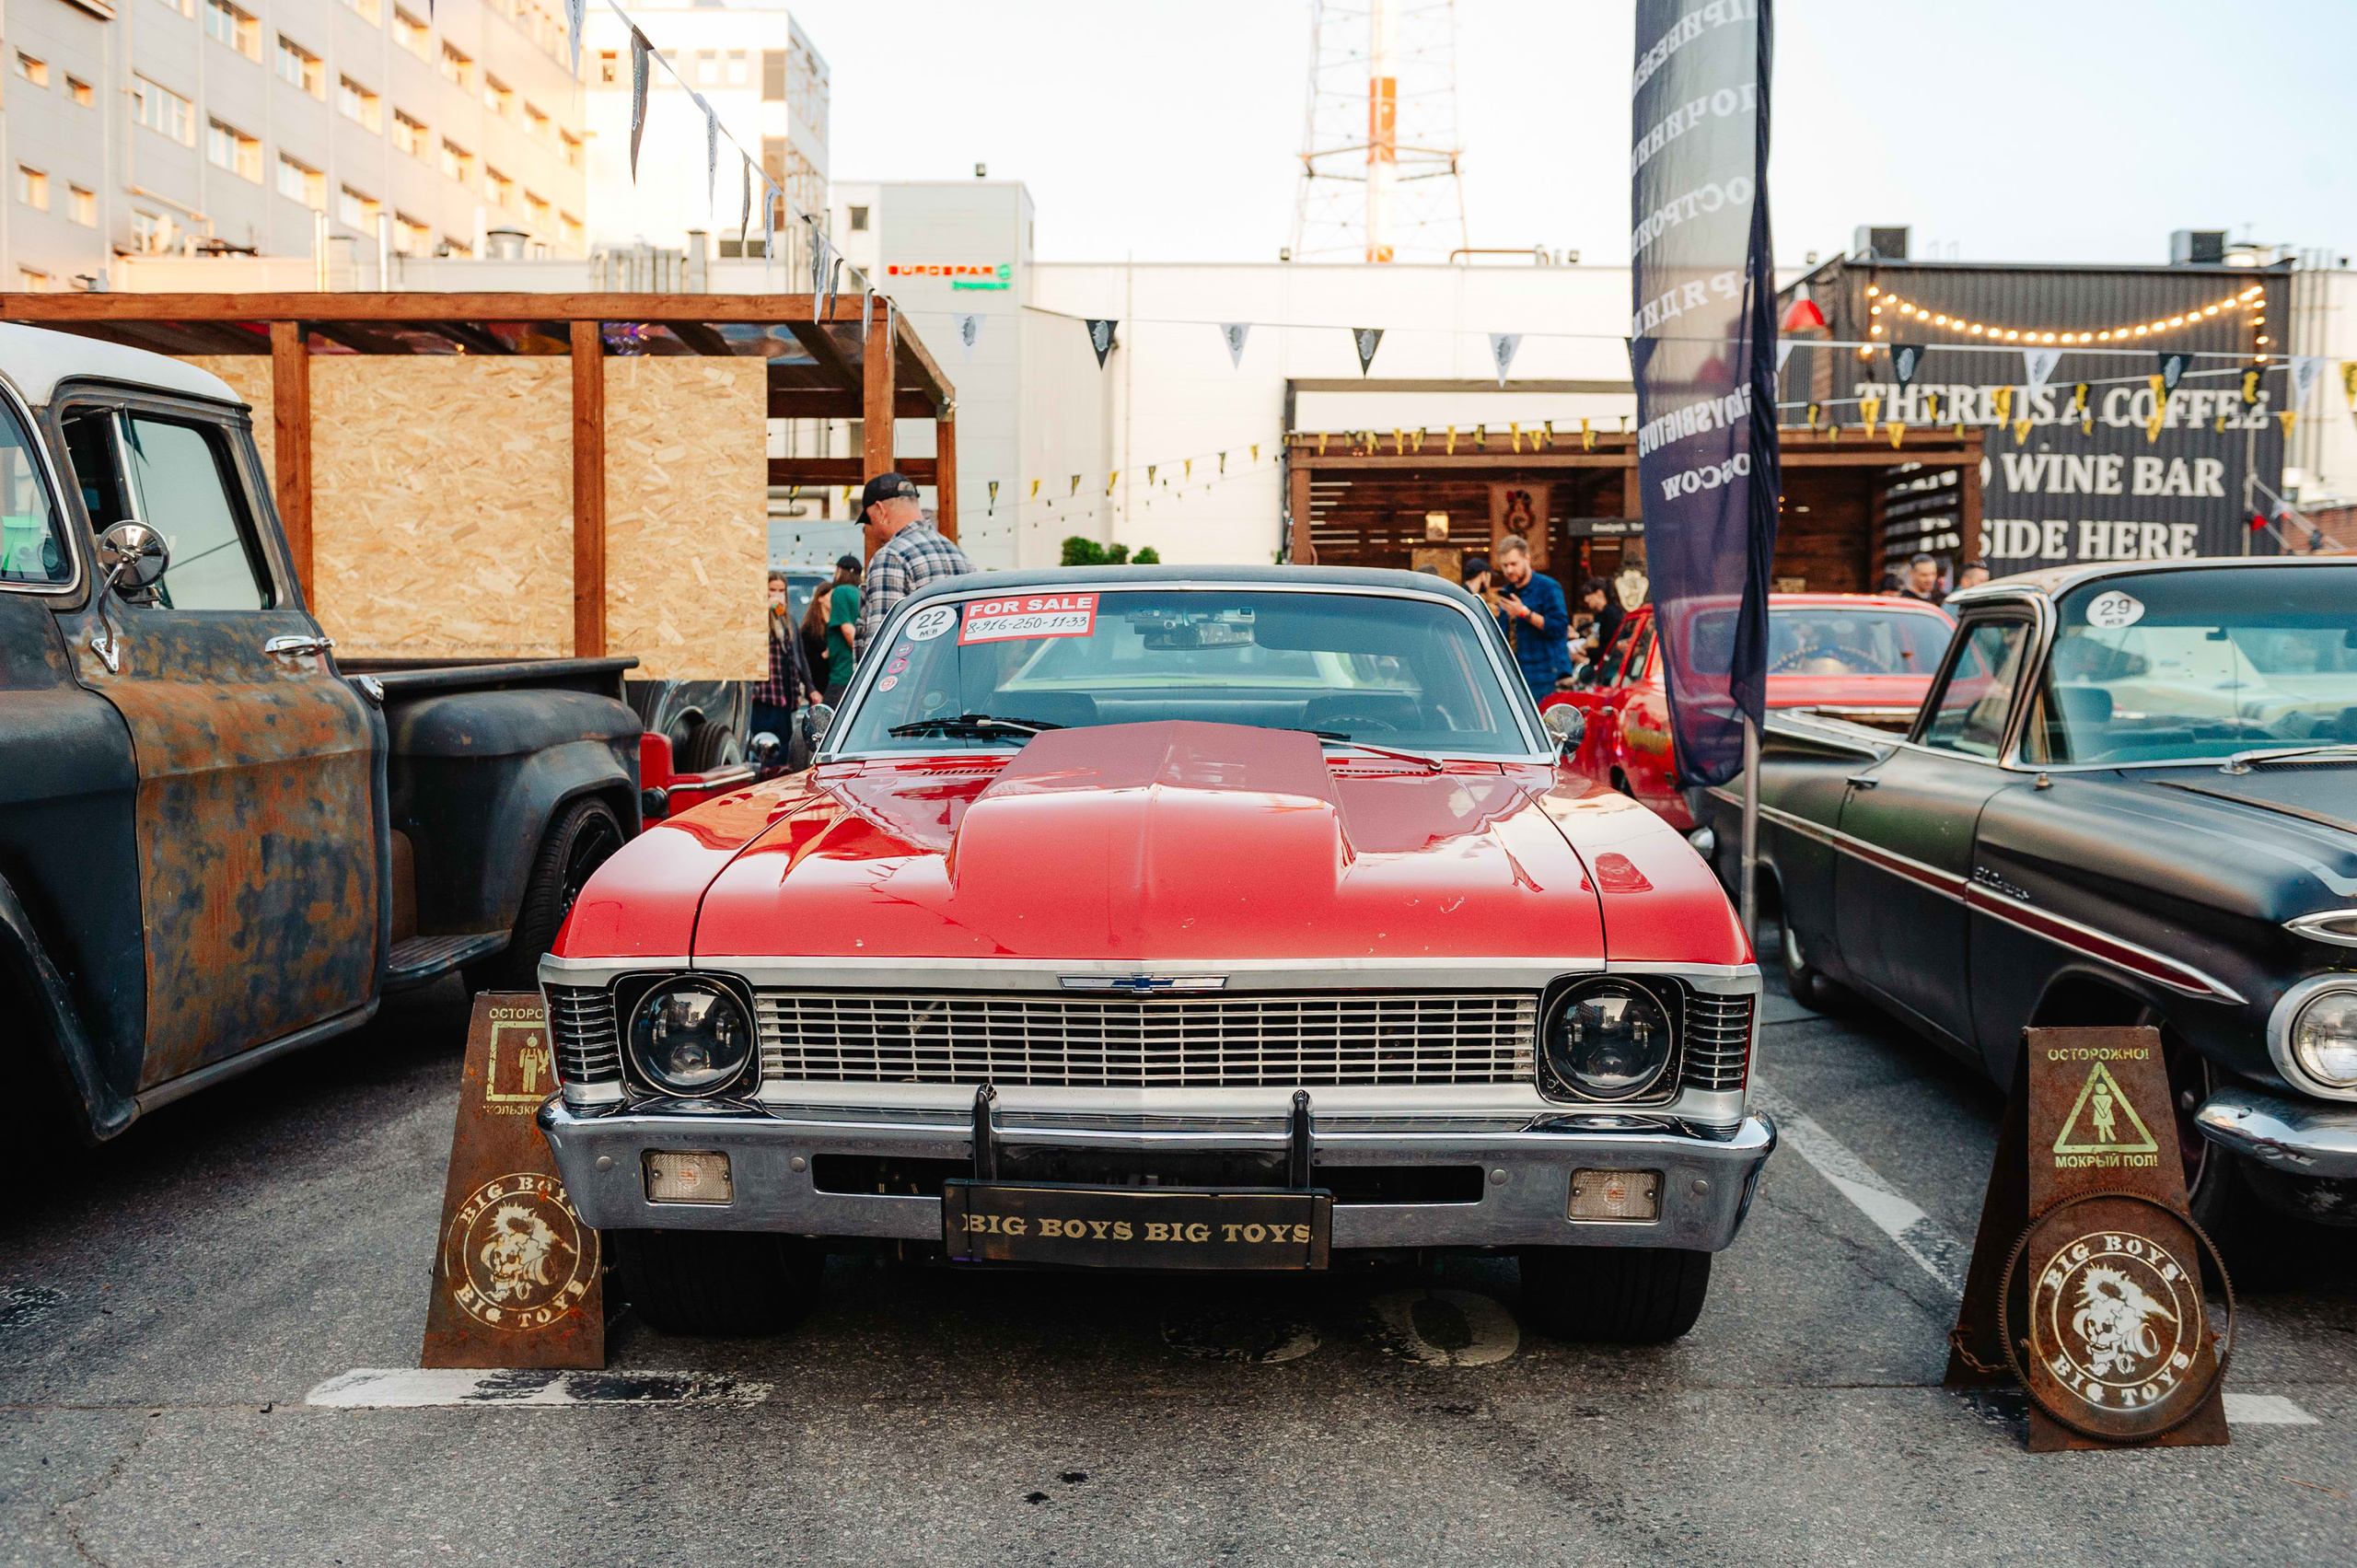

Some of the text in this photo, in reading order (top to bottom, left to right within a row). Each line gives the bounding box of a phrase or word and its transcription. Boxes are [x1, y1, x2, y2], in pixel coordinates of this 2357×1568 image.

[2102, 387, 2270, 430] COFFEE
[2000, 452, 2124, 495] WINE
[2131, 456, 2226, 498] BAR
[2077, 519, 2199, 561] HERE
[916, 610, 946, 630] 22
[969, 597, 1093, 617] FOR SALE
[2100, 598, 2131, 616] 29
[489, 1007, 544, 1019] ОСТОРО
[2047, 1048, 2149, 1061] ОСТОРОЖНО!
[2055, 1153, 2158, 1167] МОКРЫЙ ПОЛ!
[459, 1183, 504, 1225] BIG
[961, 1213, 1314, 1244] BIG BOYS BIG TOYS
[2043, 1243, 2090, 1290] BIG
[458, 1280, 585, 1328] BIG TOYS
[2050, 1351, 2190, 1406] BIG TOYS
